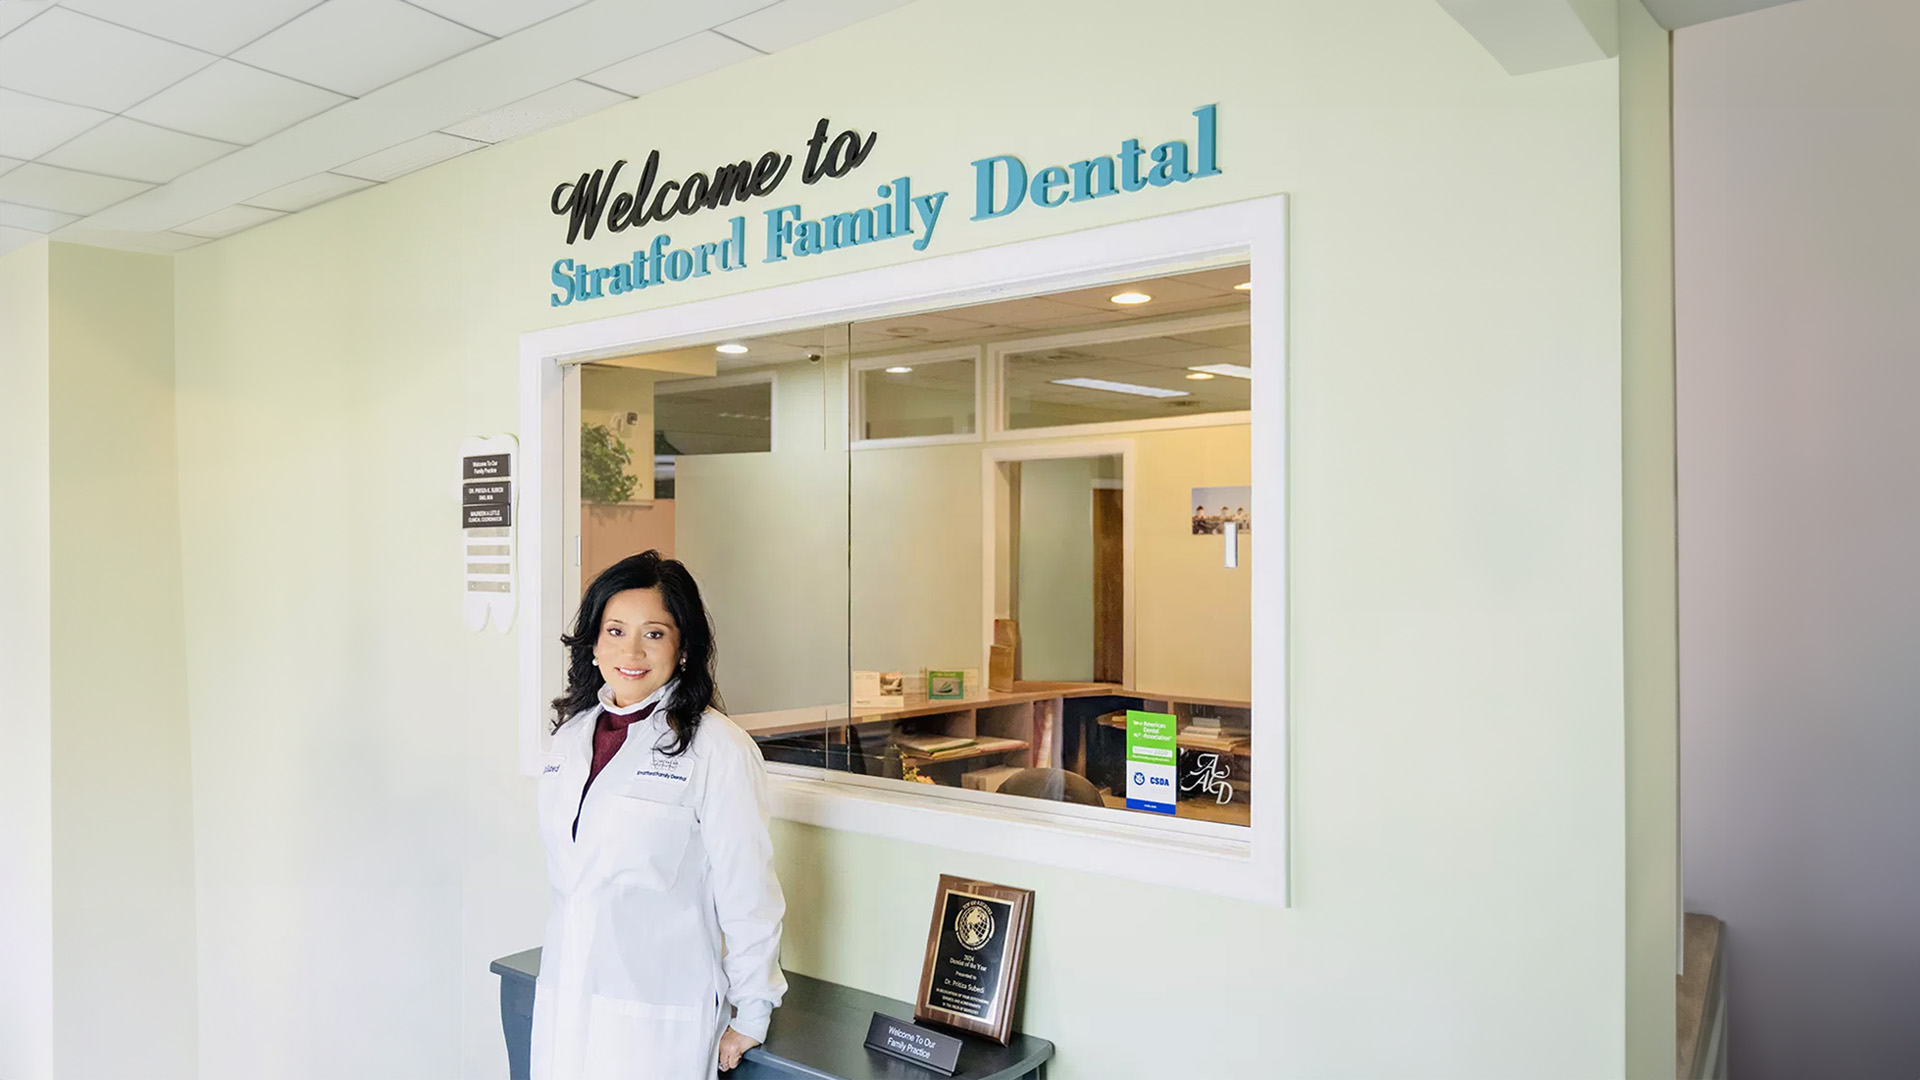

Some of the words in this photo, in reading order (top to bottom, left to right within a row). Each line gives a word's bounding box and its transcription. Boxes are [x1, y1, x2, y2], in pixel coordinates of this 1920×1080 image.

[551, 149, 794, 245] Welcome
[801, 118, 877, 185] to
[550, 215, 747, 308] Stratford
[762, 176, 949, 264] Family
[970, 103, 1223, 221] Dental
[1143, 720, 1166, 728] American
[1150, 776, 1169, 786] CSDA
[977, 963, 988, 972] Year
[967, 984, 985, 993] Subedi
[888, 1026, 915, 1041] Welcome
[916, 1034, 923, 1045] To
[924, 1038, 936, 1048] Our
[887, 1037, 906, 1052] Family
[906, 1044, 931, 1059] Practice
